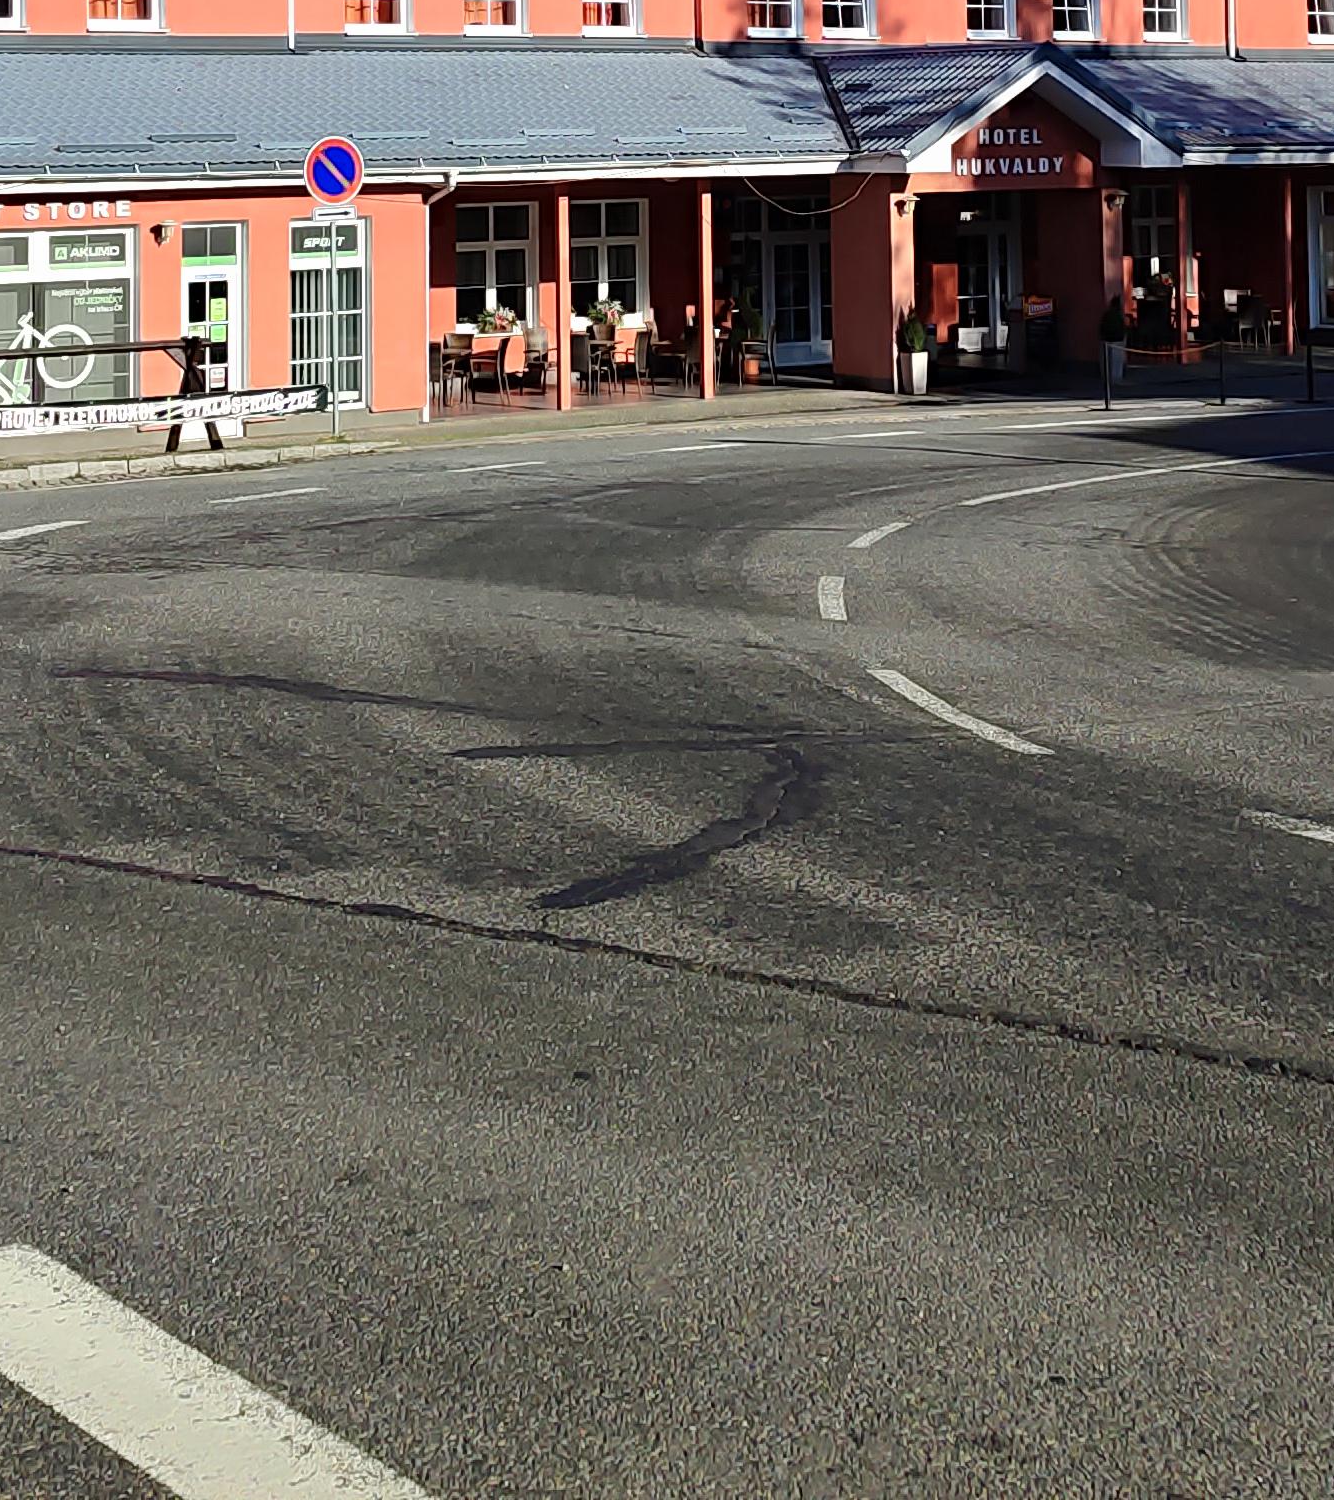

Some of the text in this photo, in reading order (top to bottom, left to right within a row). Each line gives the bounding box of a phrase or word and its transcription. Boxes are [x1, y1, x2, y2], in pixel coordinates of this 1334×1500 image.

[979, 128, 1043, 145] HOTEL
[956, 156, 1064, 176] HUKVALDY
[23, 200, 133, 222] STORE
[303, 236, 346, 249] SPOT
